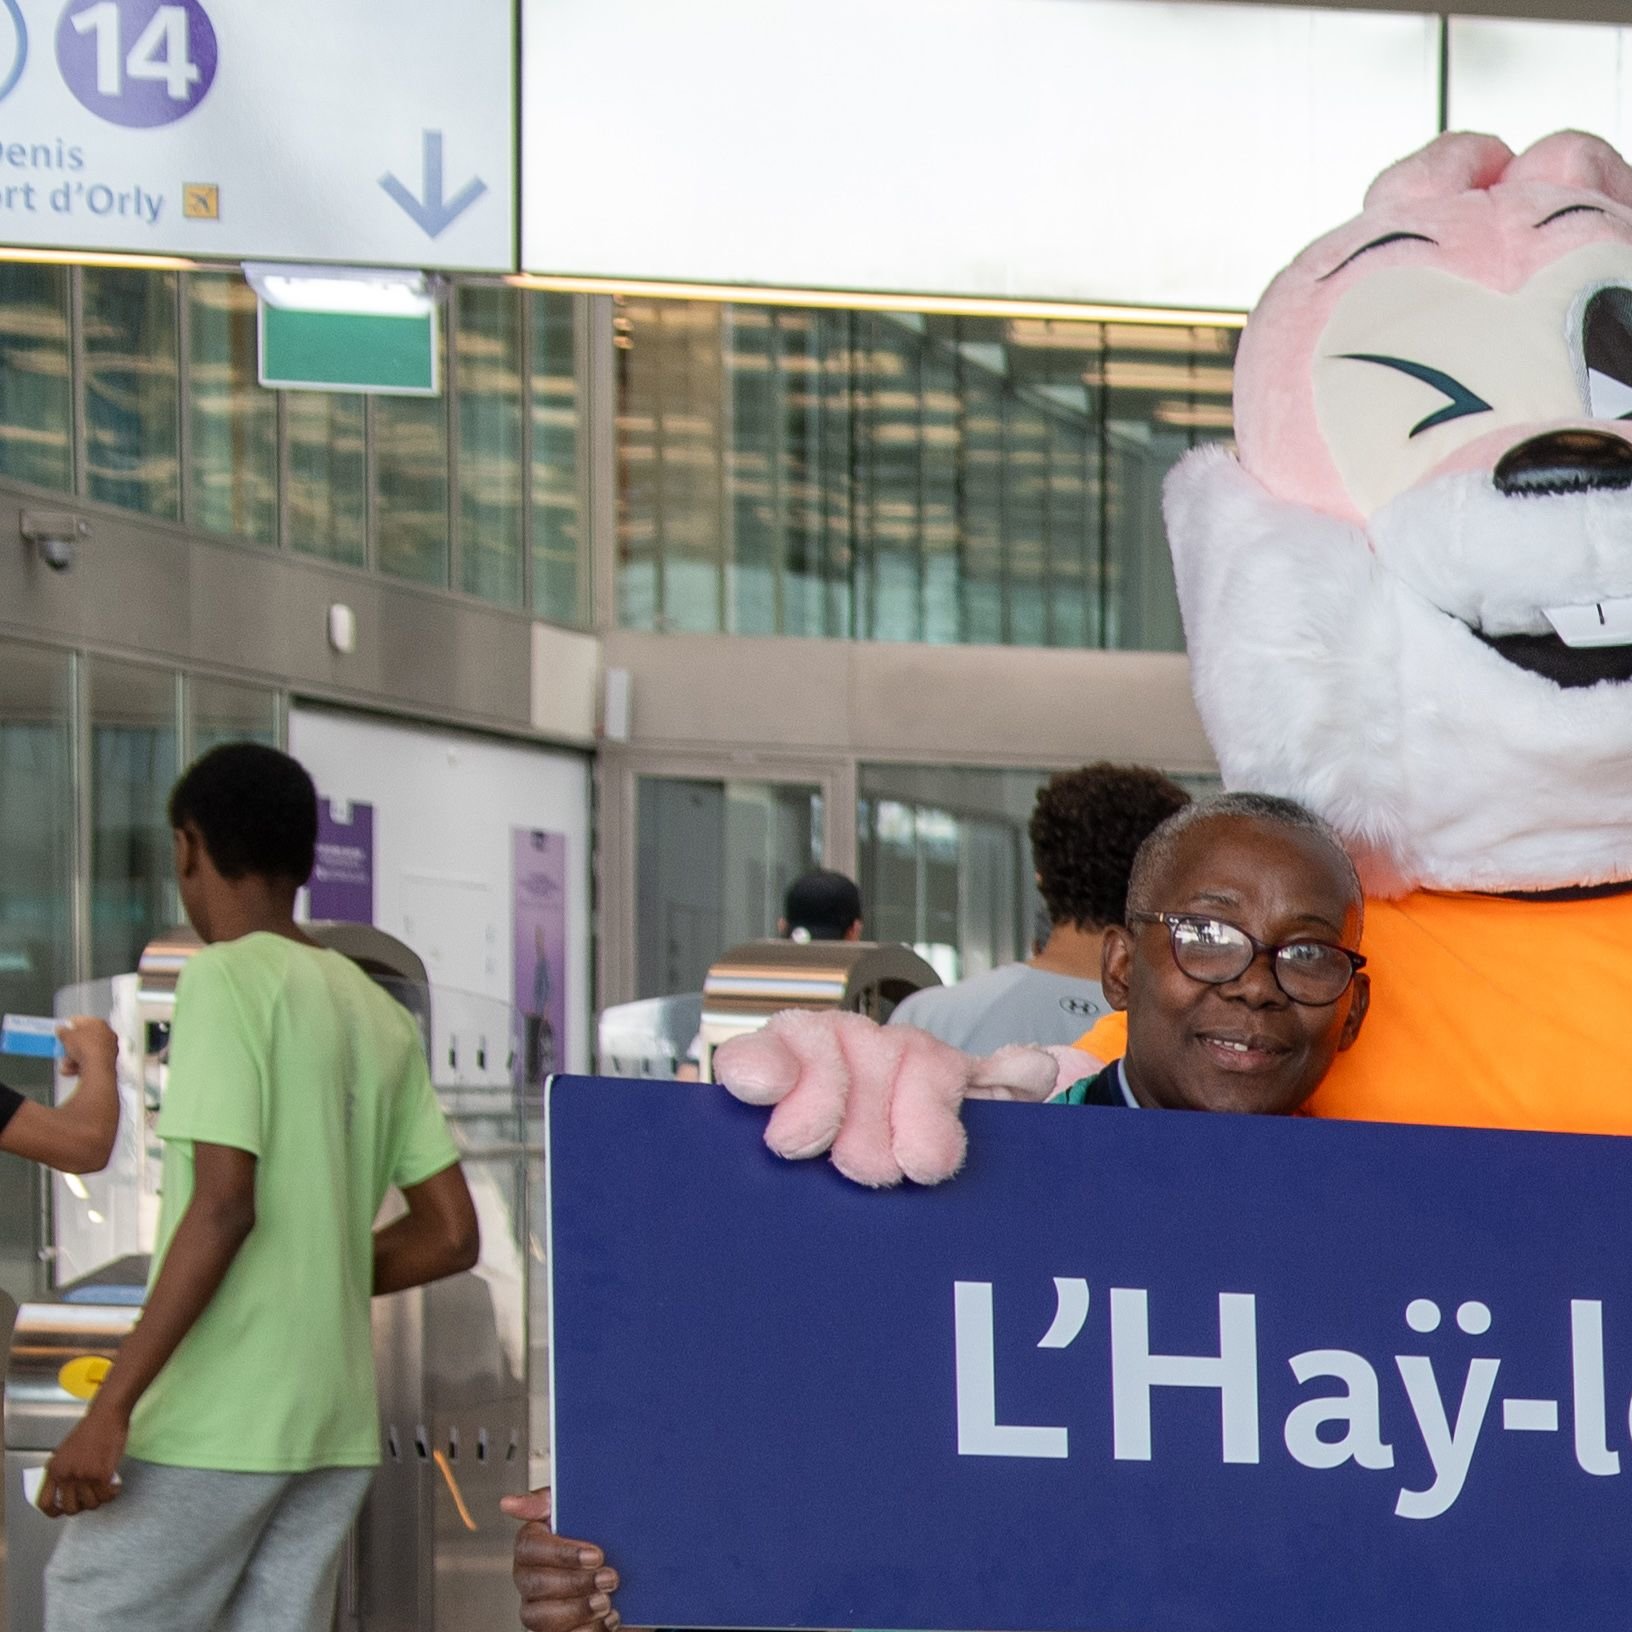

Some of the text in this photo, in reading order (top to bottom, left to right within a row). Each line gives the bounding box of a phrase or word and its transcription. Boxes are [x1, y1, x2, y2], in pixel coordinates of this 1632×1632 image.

[70, 1, 200, 100] 14
[0, 138, 84, 170] enis
[0, 181, 164, 225] rt d’Orly
